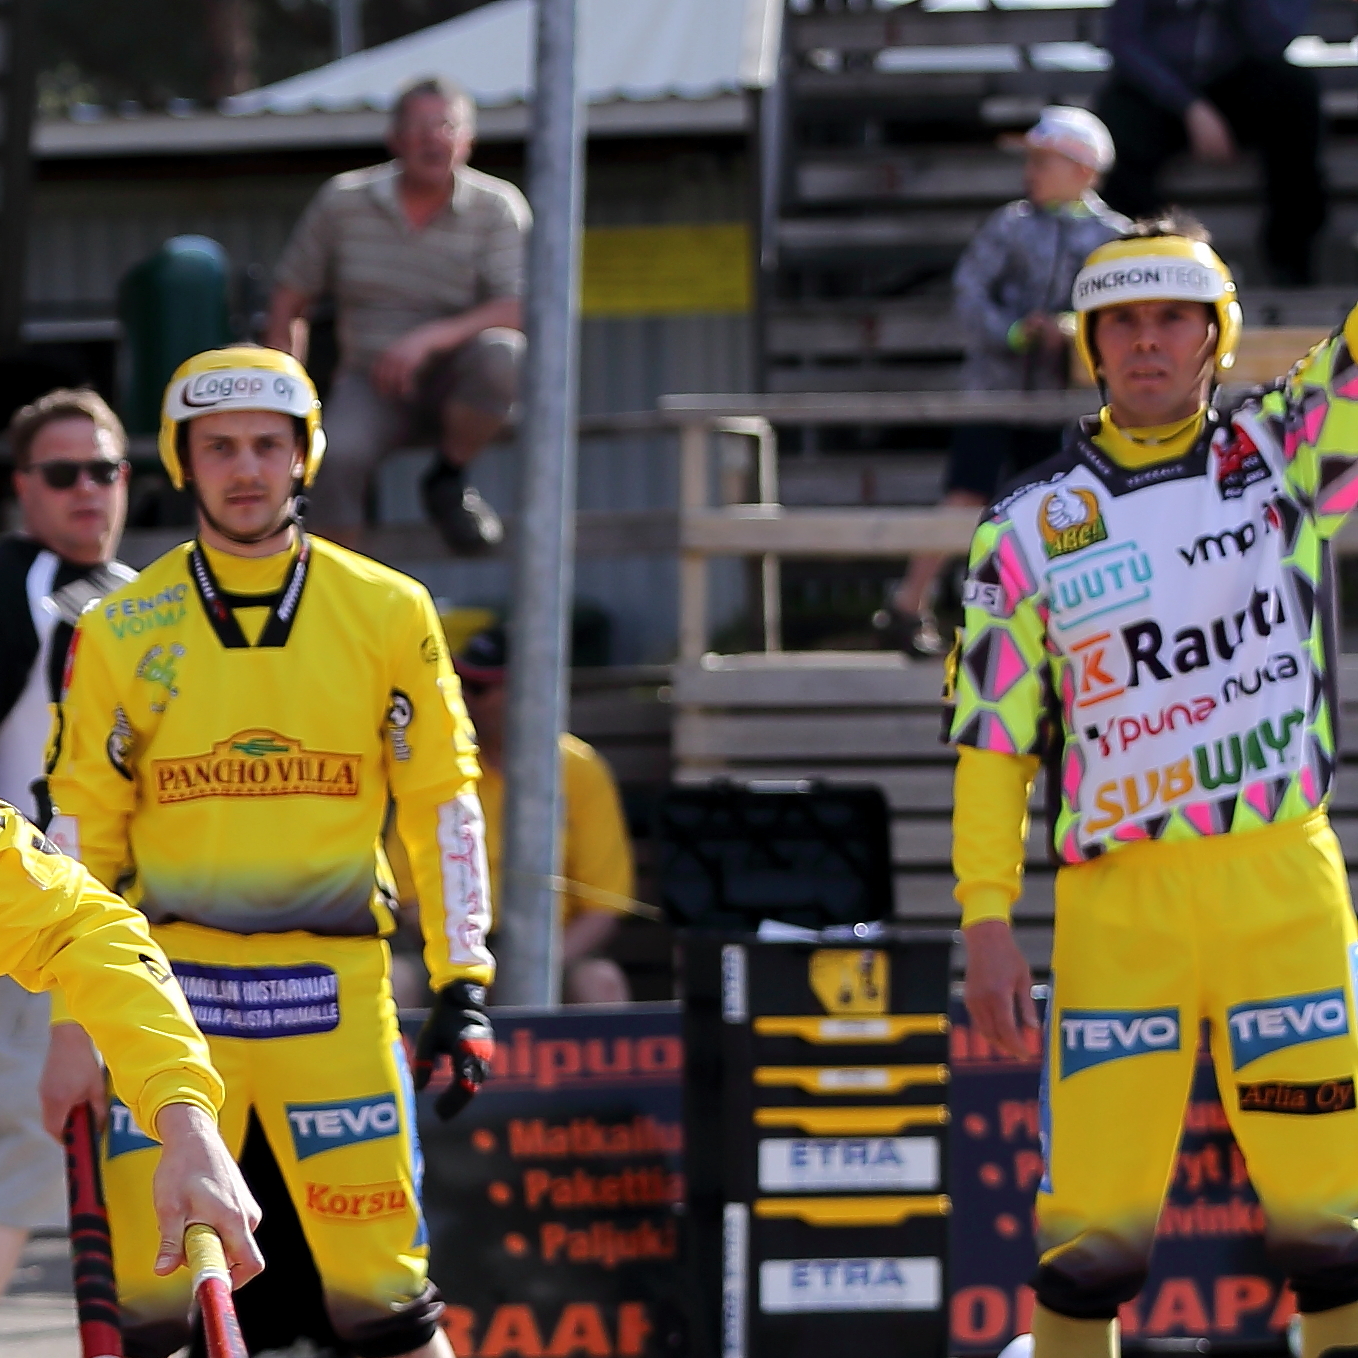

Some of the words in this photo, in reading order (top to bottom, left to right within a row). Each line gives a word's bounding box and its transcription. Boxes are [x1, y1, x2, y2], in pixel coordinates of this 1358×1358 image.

[1178, 521, 1257, 566] vmp
[157, 757, 269, 793] PANCHO
[274, 755, 357, 788] VILLA
[1060, 1015, 1179, 1051] TEVO
[1228, 1000, 1346, 1042] TEVO
[288, 1101, 399, 1139] TEVO
[304, 1182, 409, 1216] Korsu
